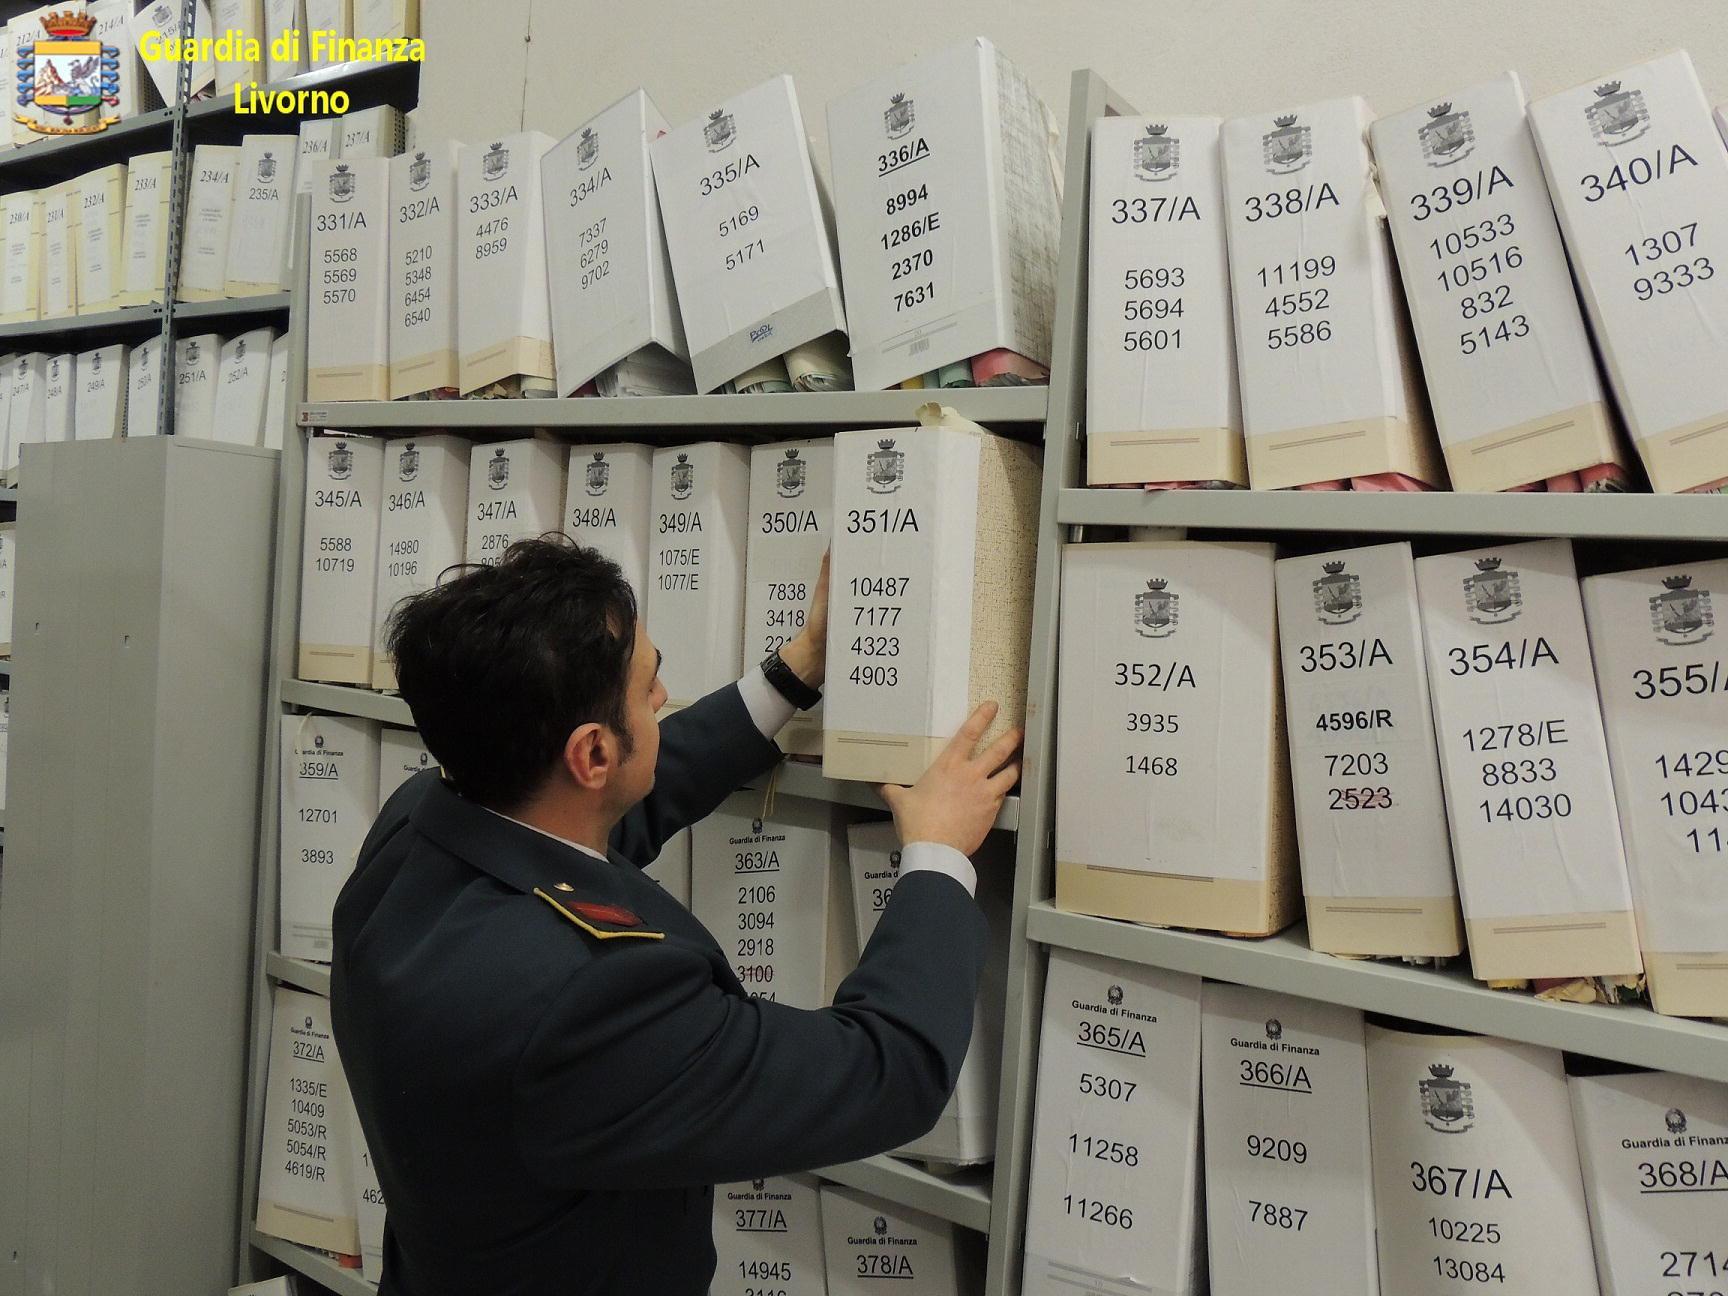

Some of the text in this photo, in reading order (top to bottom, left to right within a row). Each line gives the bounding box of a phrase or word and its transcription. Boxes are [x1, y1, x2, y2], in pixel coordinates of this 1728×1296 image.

[878, 137, 930, 172] 336/A
[200, 170, 229, 183] 234/A
[700, 153, 760, 196] 335/A
[1580, 143, 1698, 202] 340/A
[249, 188, 278, 200] 235/A
[569, 167, 611, 207] 334/A
[1410, 165, 1515, 221] 339/A
[399, 196, 440, 223] 332/A
[470, 185, 518, 214] 333/A
[886, 183, 929, 216] 8994
[1111, 196, 1201, 224] 337/A
[1245, 182, 1340, 222] 338/A
[316, 211, 367, 232] 331/A
[475, 217, 509, 238] 4476
[718, 205, 760, 237] 5169
[881, 212, 940, 250] 1286/E
[579, 218, 607, 248] 7337
[1430, 213, 1515, 260] 10533
[1625, 222, 1698, 266] 1307
[323, 248, 358, 263] 5568
[405, 245, 432, 265] 5210
[475, 238, 507, 260] 8959
[579, 239, 609, 269] 6279
[726, 239, 765, 271] 5171
[581, 260, 610, 290] 9702
[892, 248, 933, 280] 2370
[1257, 255, 1336, 288] 11199
[1437, 245, 1523, 292] 10516
[323, 268, 357, 284] 5569
[405, 266, 431, 286] 5348
[1124, 267, 1185, 289] 5693
[1633, 257, 1714, 301] 9333
[323, 289, 356, 305] 5570
[404, 287, 431, 306] 6454
[894, 281, 935, 312] 7631
[1265, 288, 1329, 318] 4552
[1461, 284, 1513, 319] 832
[404, 307, 430, 327] 6540
[1124, 298, 1184, 321] 5694
[1123, 329, 1181, 351] 5601
[1267, 320, 1331, 350] 5586
[1460, 315, 1530, 355] 5143
[179, 370, 206, 384] 251/A
[314, 490, 362, 508] 345/A
[388, 491, 425, 512] 346/A
[477, 500, 517, 522] 347/A
[572, 508, 617, 528] 348/A
[761, 510, 818, 534] 350/A
[847, 508, 919, 534] 351/A
[659, 512, 702, 534] 349/A
[320, 537, 352, 552] 5588
[389, 540, 419, 556] 14980
[482, 534, 509, 549] 2876
[316, 558, 355, 573] 10719
[659, 549, 700, 566] 1075/E
[388, 561, 418, 577] 10196
[658, 574, 699, 591] 1077/E
[768, 583, 806, 601] 7838
[851, 577, 910, 597] 10487
[766, 609, 805, 627] 3418
[853, 607, 902, 627] 7177
[851, 637, 900, 656] 4323
[1299, 638, 1394, 673] 353/A
[1448, 636, 1560, 676] 354/A
[849, 666, 898, 687] 4903
[1114, 661, 1196, 692] 352/A
[1632, 661, 1728, 699] 355/
[1126, 713, 1179, 733] 3935
[1316, 709, 1394, 731] 4596/R
[1463, 719, 1568, 752] 1278/E
[300, 762, 338, 777] 359/A
[1125, 755, 1178, 777] 1468
[1324, 753, 1389, 776] 7203
[1482, 758, 1557, 786] 8833
[1328, 787, 1393, 810] 2523
[1479, 793, 1572, 823] 14030
[299, 809, 337, 823] 12701
[729, 834, 785, 845] Guardia di Finanza
[1687, 827, 1728, 852] 11
[301, 849, 334, 864] 3893
[735, 851, 780, 870] 363/A
[864, 871, 892, 879] Guardia
[738, 885, 776, 904] 2106
[738, 912, 774, 930] 3094
[737, 938, 774, 956] 2918
[738, 965, 773, 982] 3100
[1071, 999, 1158, 1023] Guardia di Finanza
[1078, 1021, 1146, 1053] 365/A
[1230, 1037, 1320, 1056] Guardia di Finanza
[293, 1041, 324, 1059] 372/A
[1240, 1059, 1312, 1089] 366/A
[289, 1078, 328, 1098] 1335/E
[1079, 1072, 1137, 1102] 5307
[291, 1099, 325, 1118] 10409
[287, 1118, 327, 1140] 5053/R
[287, 1140, 326, 1161] 5054/R
[1069, 1133, 1139, 1167] 11258
[1247, 1135, 1308, 1164] 9209
[1621, 1138, 1670, 1149] Guardia
[1674, 1137, 1686, 1147] di
[285, 1160, 325, 1182] 4619/R
[1410, 1161, 1512, 1199] 367/A
[1638, 1160, 1728, 1187] 368/A
[727, 1192, 792, 1201] Guardia di Finanza
[735, 1209, 787, 1229] 377/A
[1063, 1194, 1134, 1230] 11266
[1249, 1200, 1308, 1231] 7887
[847, 1236, 917, 1246] Guardia di Finanza
[1428, 1217, 1501, 1244] 10225
[739, 1260, 791, 1281] 14945
[856, 1254, 914, 1276] 378/A
[1433, 1256, 1505, 1283] 13084
